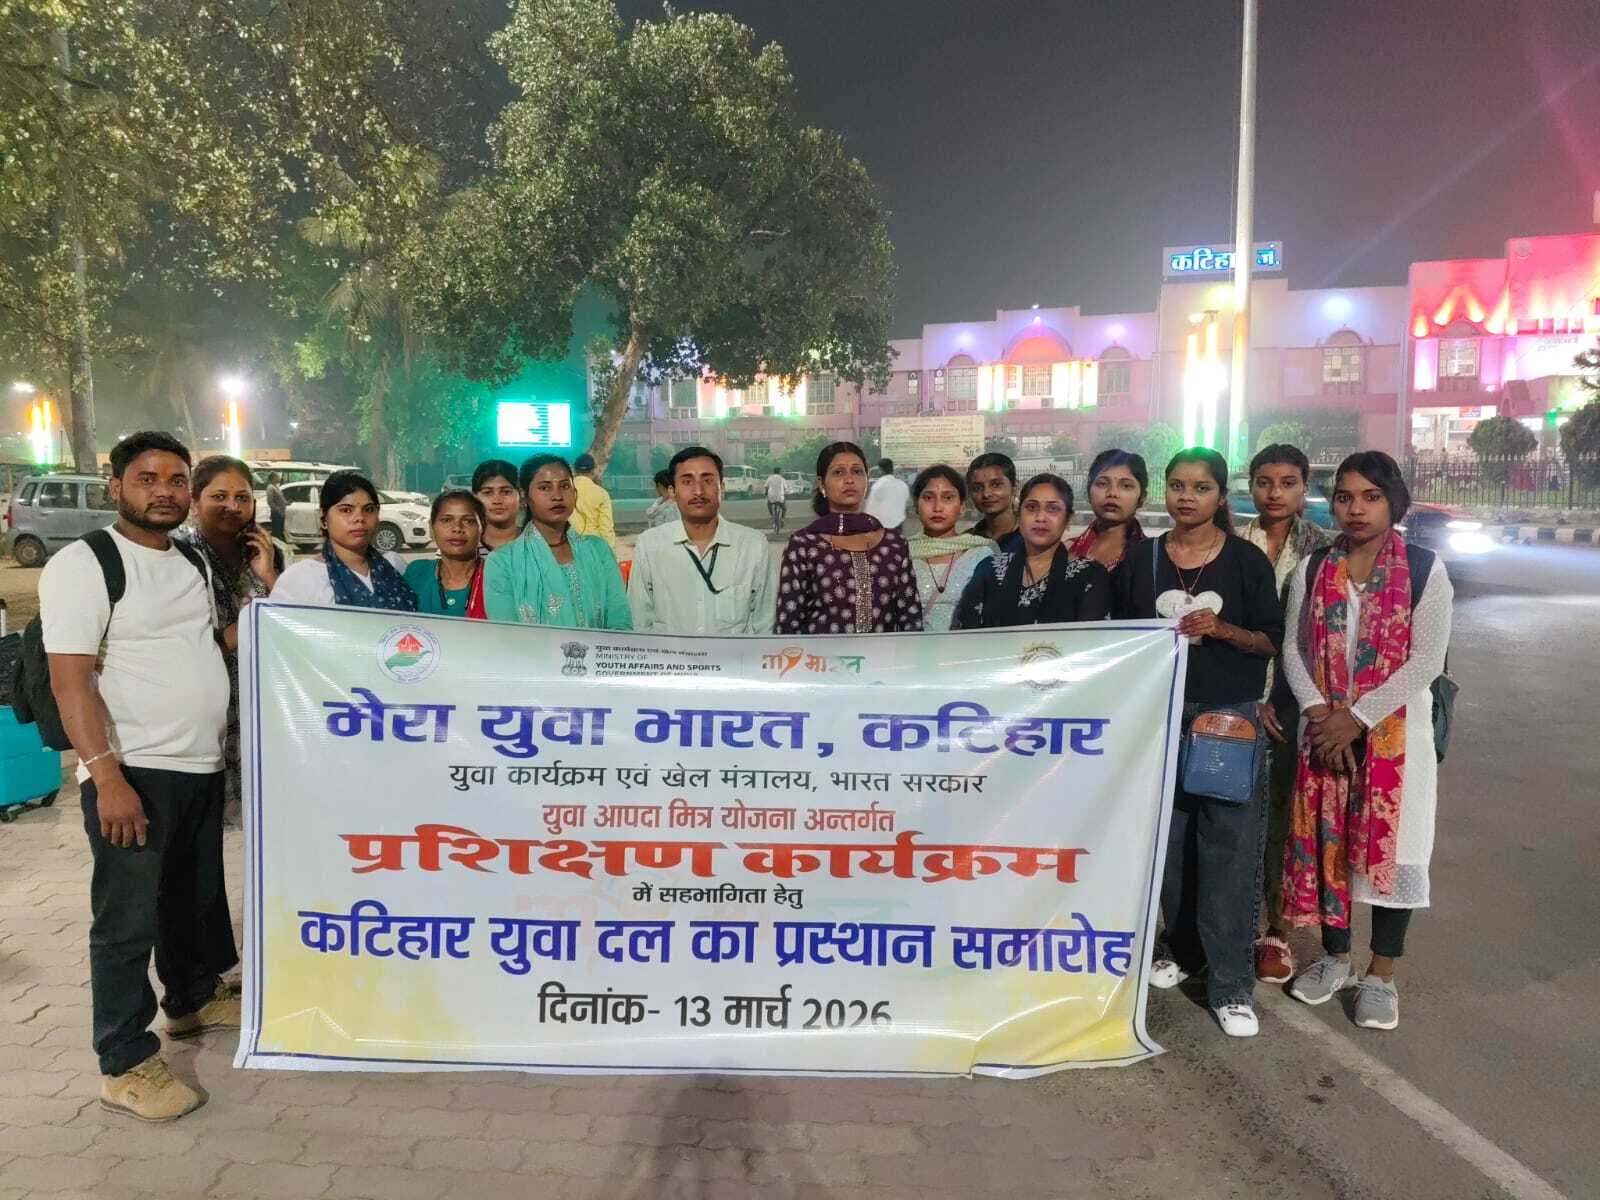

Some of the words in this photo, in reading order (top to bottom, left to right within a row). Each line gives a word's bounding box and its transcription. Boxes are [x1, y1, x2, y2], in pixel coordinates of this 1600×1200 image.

[1171, 247, 1237, 271] कटिहा
[687, 664, 721, 672] SPORTS
[323, 687, 456, 743] मेरा
[477, 706, 611, 758] युवा
[635, 709, 834, 758] भारत,
[859, 702, 1110, 756] कटिहार
[449, 765, 496, 791] युवा
[507, 760, 607, 788] कार्यक्रम
[616, 764, 651, 789] एवं
[662, 762, 711, 789] खेल
[720, 766, 818, 793] मंत्रालय,
[830, 772, 890, 793] भारत
[901, 774, 987, 794] सरकार
[543, 805, 586, 835] युवा
[594, 805, 662, 828] आपदा
[669, 798, 713, 829] मित्र
[721, 799, 796, 831] योजना
[804, 801, 896, 832] अन्तर्गत
[338, 823, 729, 880] प्रशिक्षण
[735, 830, 1091, 884] कार्यक्रम
[632, 881, 653, 902] में
[659, 883, 767, 904] सहभागिता
[773, 886, 804, 909] हेतु
[298, 900, 475, 960] कटिहार
[488, 918, 581, 975] युवा
[595, 920, 675, 963] दल
[690, 921, 757, 964] का
[774, 921, 936, 969] प्रस्थान
[951, 913, 1136, 977] समारोह
[537, 981, 660, 1026] दिनांक-
[674, 996, 711, 1027] 13
[724, 984, 792, 1030] मार्च
[803, 998, 892, 1031] 2026
